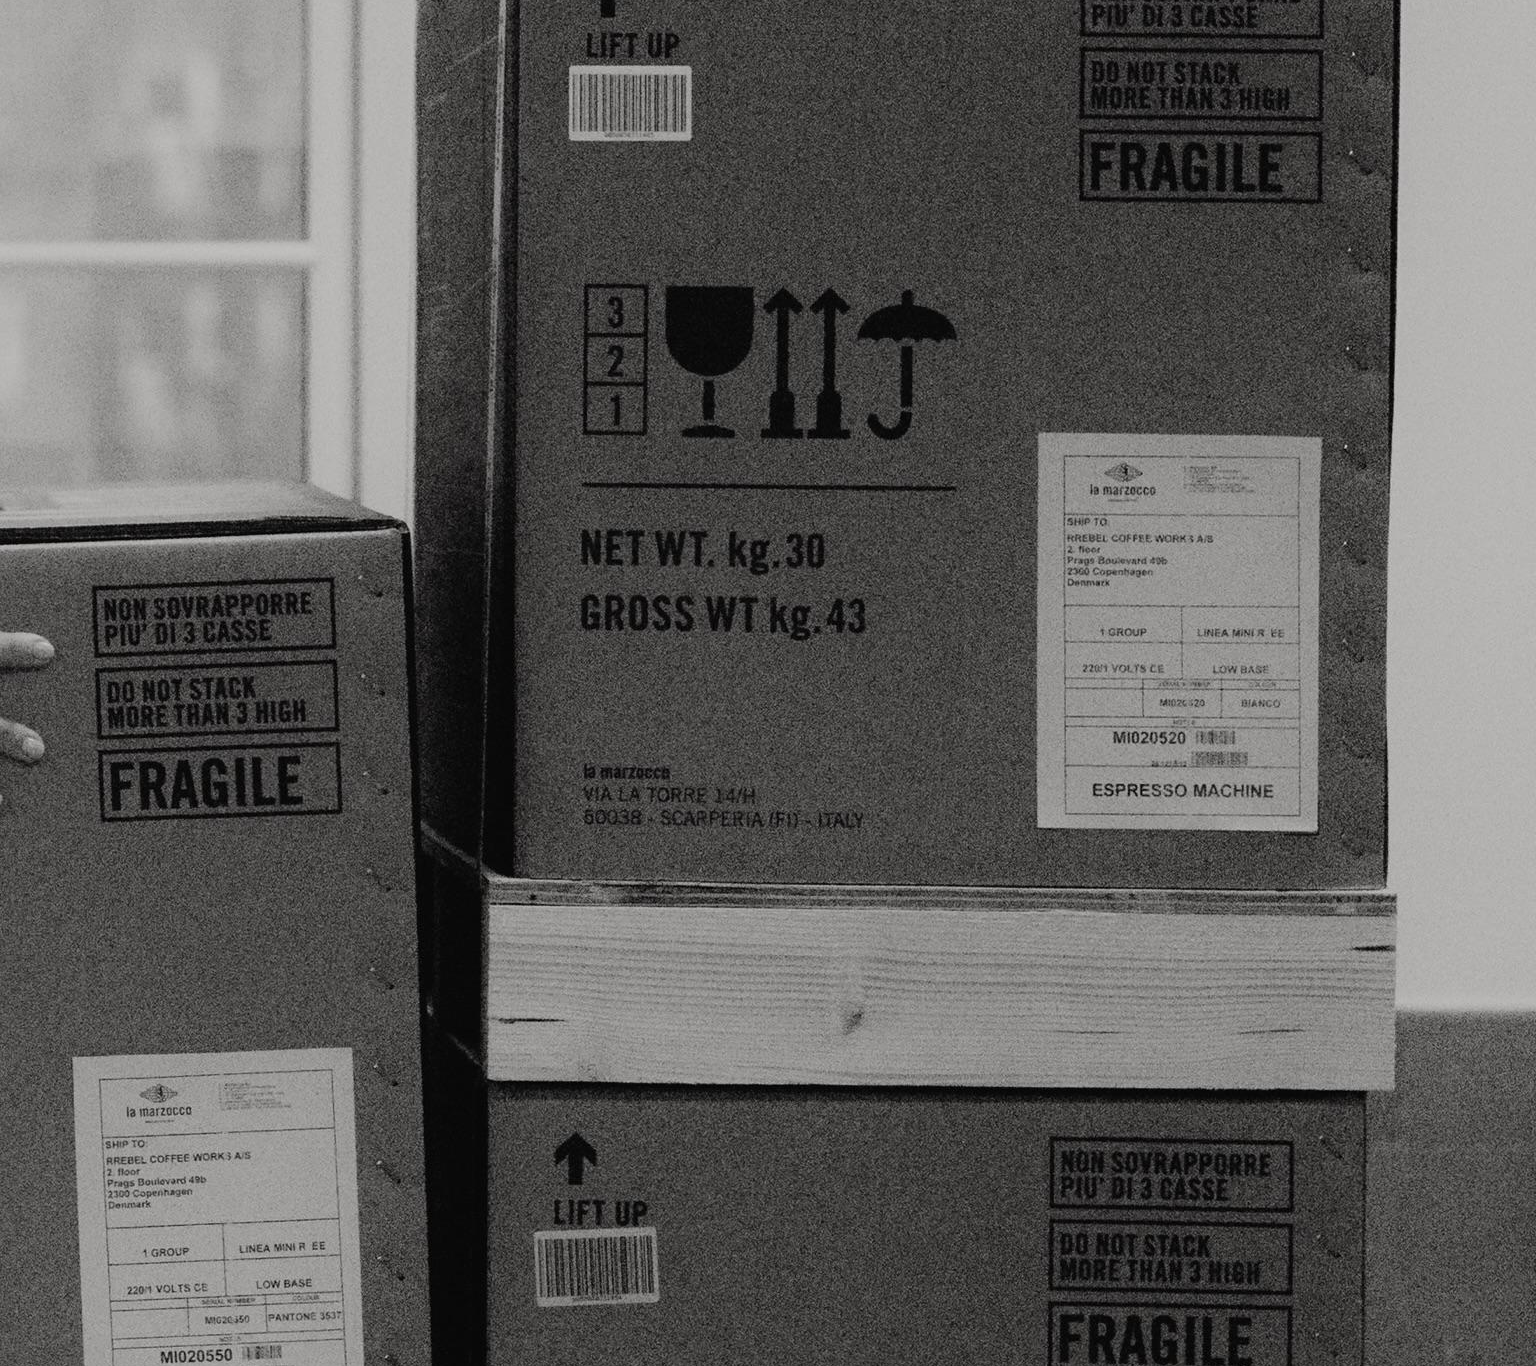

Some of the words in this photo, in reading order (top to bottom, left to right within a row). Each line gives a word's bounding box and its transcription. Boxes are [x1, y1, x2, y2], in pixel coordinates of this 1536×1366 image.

[1092, 5, 1135, 27] PIU'
[1142, 4, 1163, 27] DI
[1171, 5, 1182, 27] 3
[1191, 5, 1257, 29] CASSE
[586, 32, 637, 58] LIFT
[648, 33, 680, 58] UP
[1092, 61, 1119, 83] DO
[1127, 62, 1167, 84] NOT
[1175, 61, 1240, 85] STACK
[1091, 86, 1150, 109] MORE
[1158, 87, 1213, 109] THAN
[1220, 87, 1233, 110] 3
[1238, 87, 1290, 110] HIGH
[1091, 142, 1283, 193] FRAGILE
[608, 296, 624, 328] 3
[607, 345, 624, 377] 2
[611, 394, 621, 426] 1
[1089, 485, 1100, 495] la
[1102, 486, 1157, 495] marzocco
[581, 529, 644, 565] NET
[655, 531, 714, 567] WT.
[729, 531, 825, 575] kg.30
[104, 599, 147, 622] NON
[154, 592, 311, 620] SOVRAPPORRE
[581, 594, 693, 631] GROSS
[706, 596, 758, 632] WT
[770, 597, 866, 641] kg.43
[105, 623, 147, 646] PIU'
[155, 622, 176, 644] DI
[183, 622, 196, 644] 3
[203, 619, 271, 643] CASSE
[107, 680, 135, 703] DO
[142, 679, 182, 702] NOT
[189, 677, 255, 700] STACK
[108, 705, 167, 728] MORE
[174, 703, 229, 725] THAN
[237, 702, 248, 724] 3
[256, 700, 306, 723] HIGH
[1112, 731, 1187, 745] MI020520
[111, 755, 303, 811] FRAGILE
[583, 765, 596, 779] la
[600, 767, 670, 779] marzocco
[582, 786, 613, 801] VIA
[619, 787, 640, 801] LA
[648, 787, 706, 804] TORRE
[715, 788, 756, 804] 14/H
[1092, 783, 1188, 797] ESPRESSO
[1193, 784, 1274, 798] MACHINE
[584, 809, 642, 825] 50038
[661, 810, 764, 827] SCARPERIA
[769, 811, 800, 828] (FI)
[818, 812, 864, 829] ITALY
[126, 1107, 137, 1117] la
[138, 1106, 193, 1117] marzocco
[1062, 1151, 1104, 1173] NON
[1111, 1151, 1270, 1177] SOVRAPPORRE
[1060, 1175, 1104, 1199] PIU'
[1111, 1177, 1133, 1199] DI
[1141, 1177, 1152, 1200] 3
[1160, 1177, 1228, 1201] CASSE
[554, 1199, 605, 1225] LIFT
[616, 1201, 648, 1226] UP
[1060, 1233, 1088, 1255] DO
[1096, 1233, 1137, 1256] NOT
[1144, 1234, 1209, 1257] STACK
[1060, 1259, 1119, 1281] MORE
[1128, 1259, 1182, 1282] THAN
[1189, 1261, 1202, 1283] 3
[1208, 1262, 1260, 1284] HIGH
[1059, 1314, 1252, 1366] FRAGILE
[159, 1348, 233, 1363] MI020550
